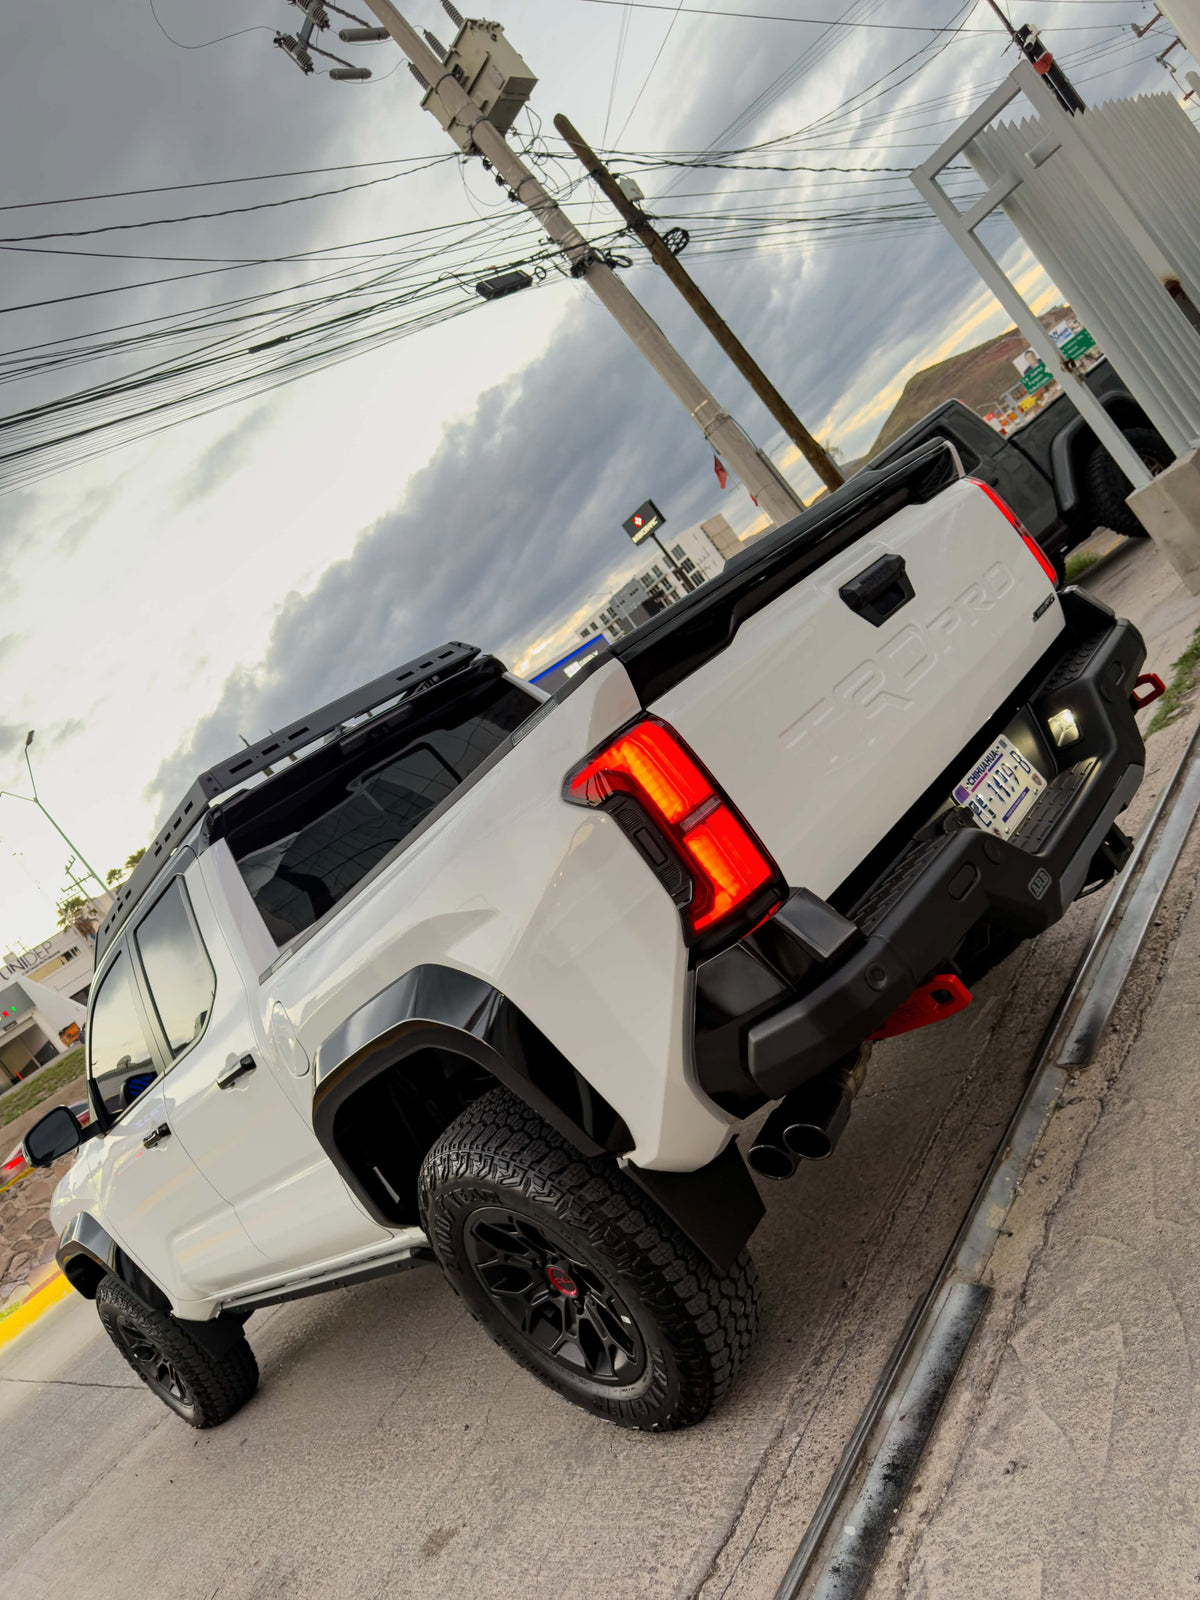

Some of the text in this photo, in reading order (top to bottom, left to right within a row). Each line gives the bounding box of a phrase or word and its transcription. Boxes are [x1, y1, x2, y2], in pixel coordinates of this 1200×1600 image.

[967, 750, 998, 786] CHIHUAHUA
[1030, 870, 1050, 898] ARB
[0, 941, 52, 980] UNIDEP
